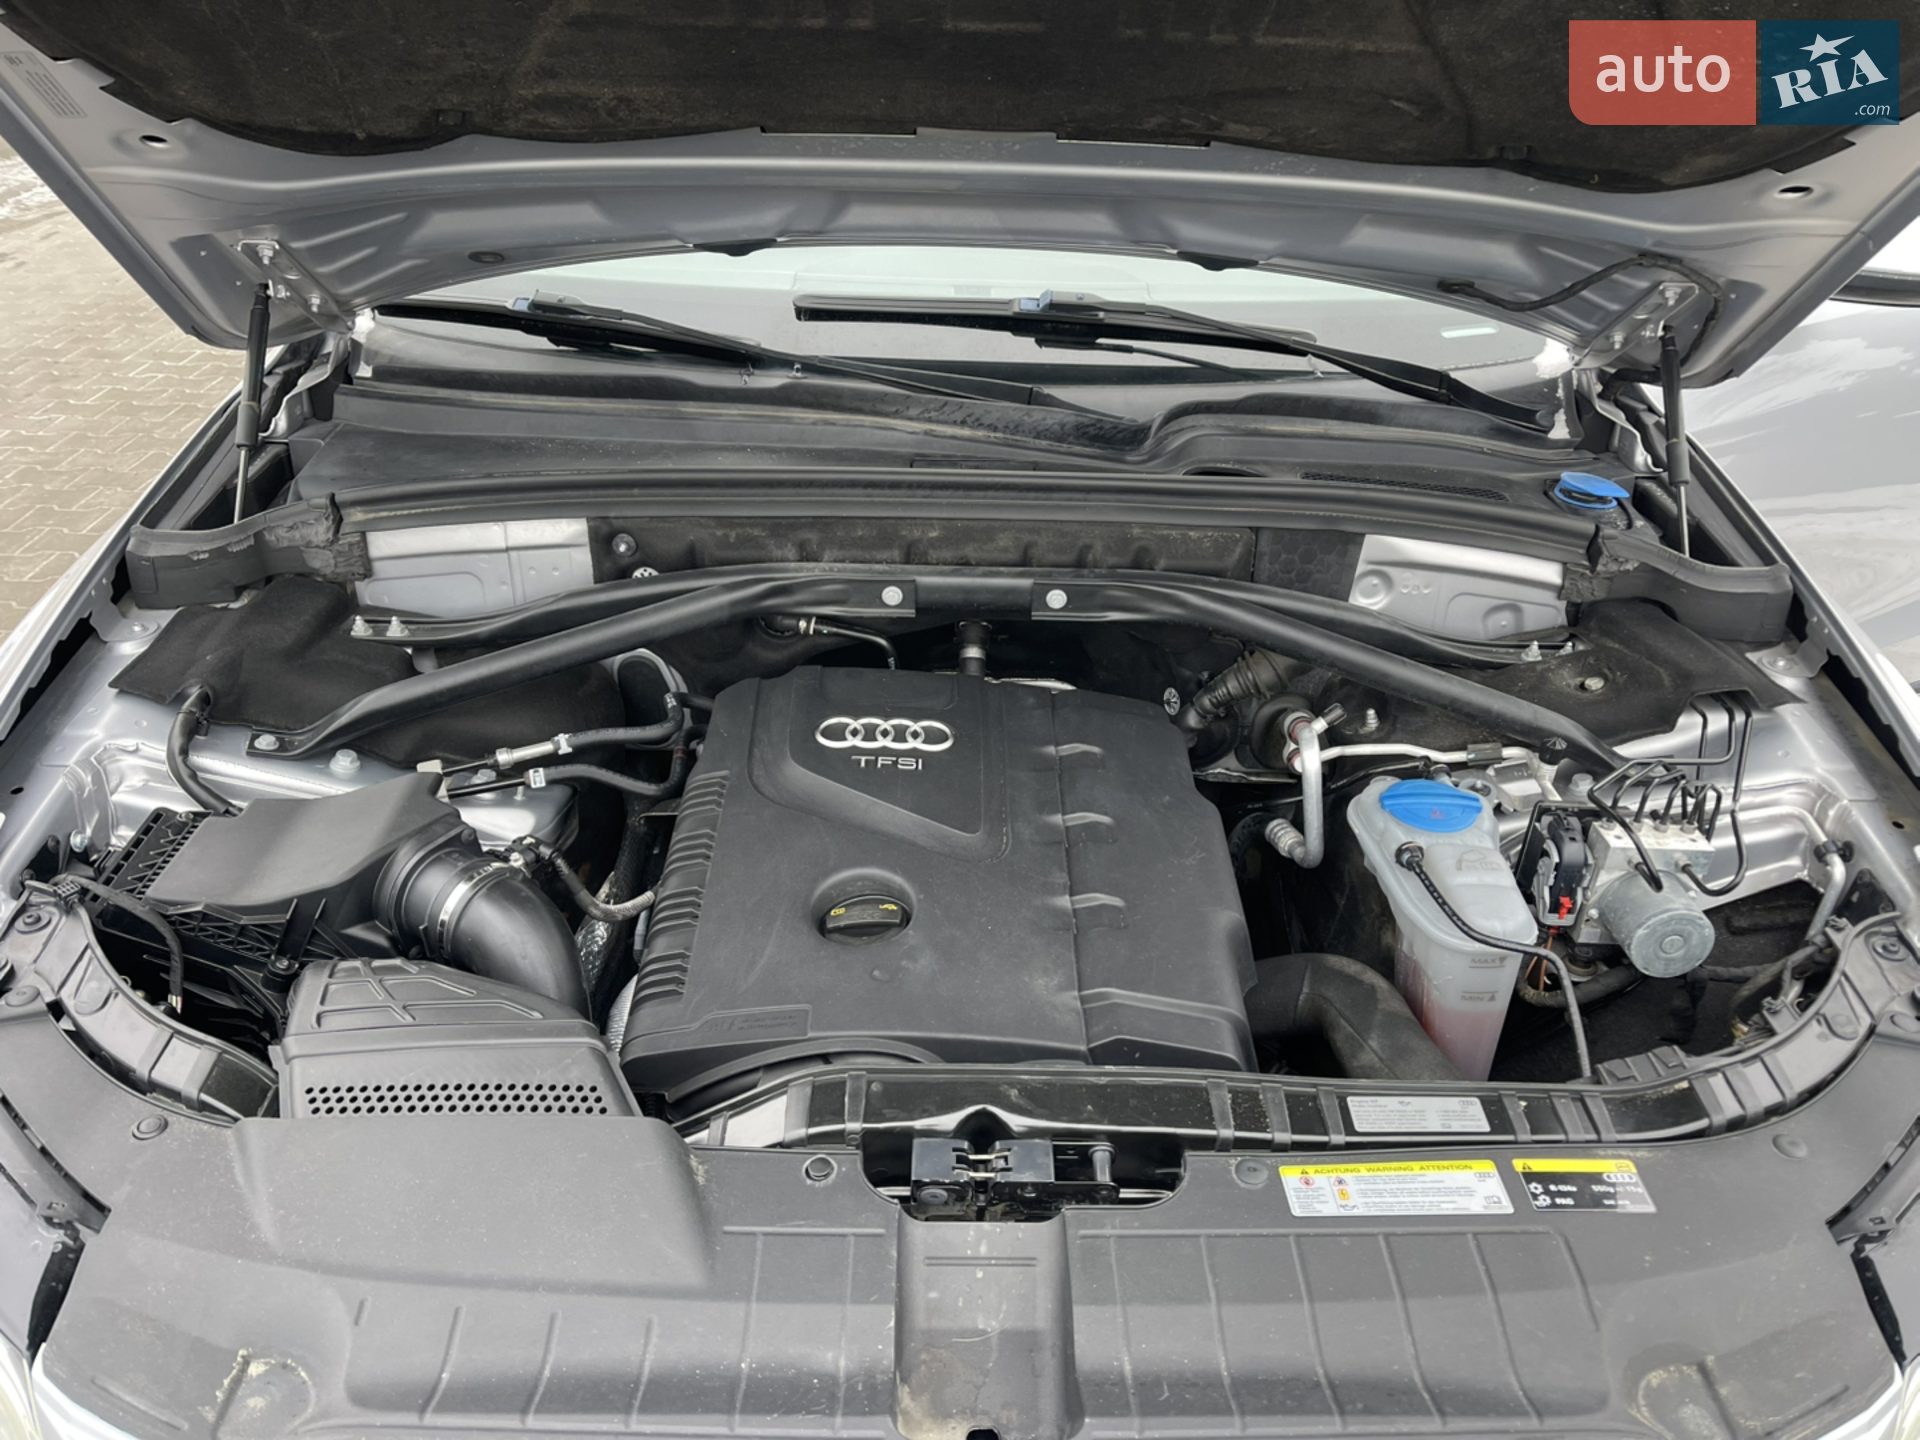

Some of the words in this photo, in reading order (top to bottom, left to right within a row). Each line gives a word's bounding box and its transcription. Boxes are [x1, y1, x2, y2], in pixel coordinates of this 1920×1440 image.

[851, 755, 923, 770] TFSI
[1313, 1166, 1361, 1175] ACHTUNG
[1365, 1164, 1414, 1173] WARNING
[1418, 1163, 1473, 1171] ATTENTION
